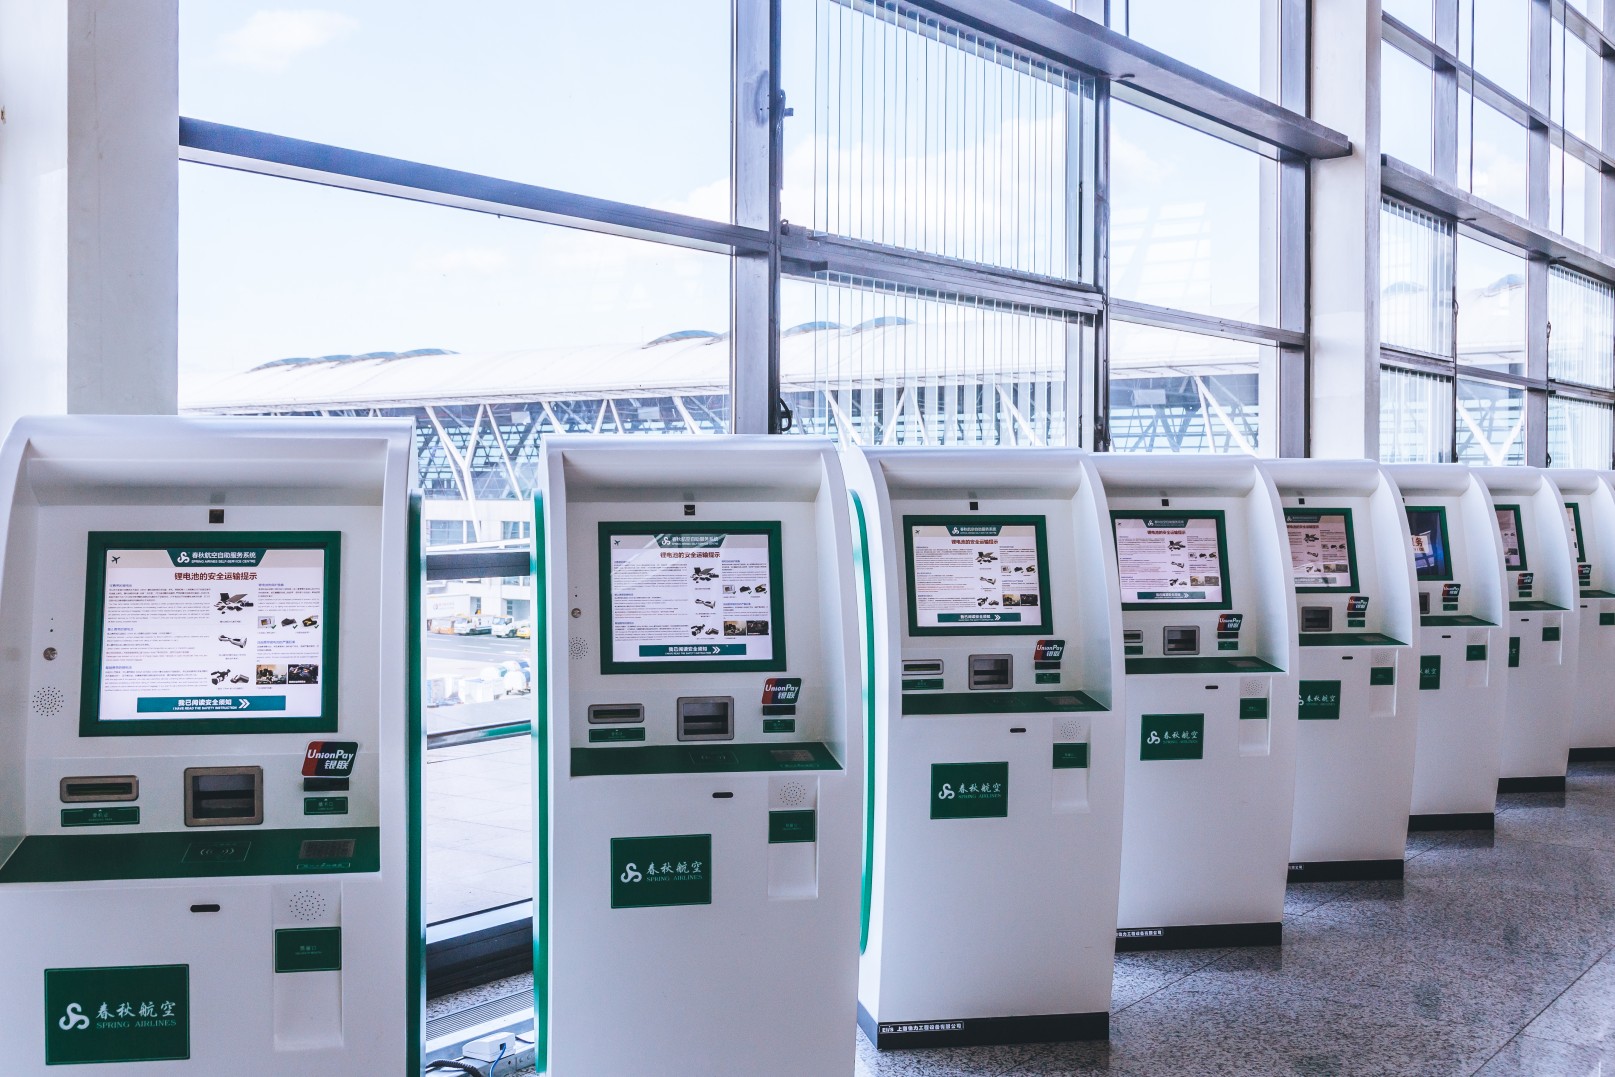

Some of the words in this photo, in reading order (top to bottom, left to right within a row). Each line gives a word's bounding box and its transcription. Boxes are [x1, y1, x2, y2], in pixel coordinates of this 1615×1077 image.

[174, 572, 257, 580] 锂电池的安全运输提示
[765, 684, 798, 692] UnionPay
[1164, 731, 1198, 739] 春秋航空
[308, 750, 354, 762] UnionPay
[324, 760, 349, 770] 银联
[958, 782, 1001, 793] 春秋航空
[646, 861, 702, 875] 春秋航空
[96, 1000, 176, 1020] 春秋航空
[135, 1019, 176, 1027] AIRLINES
